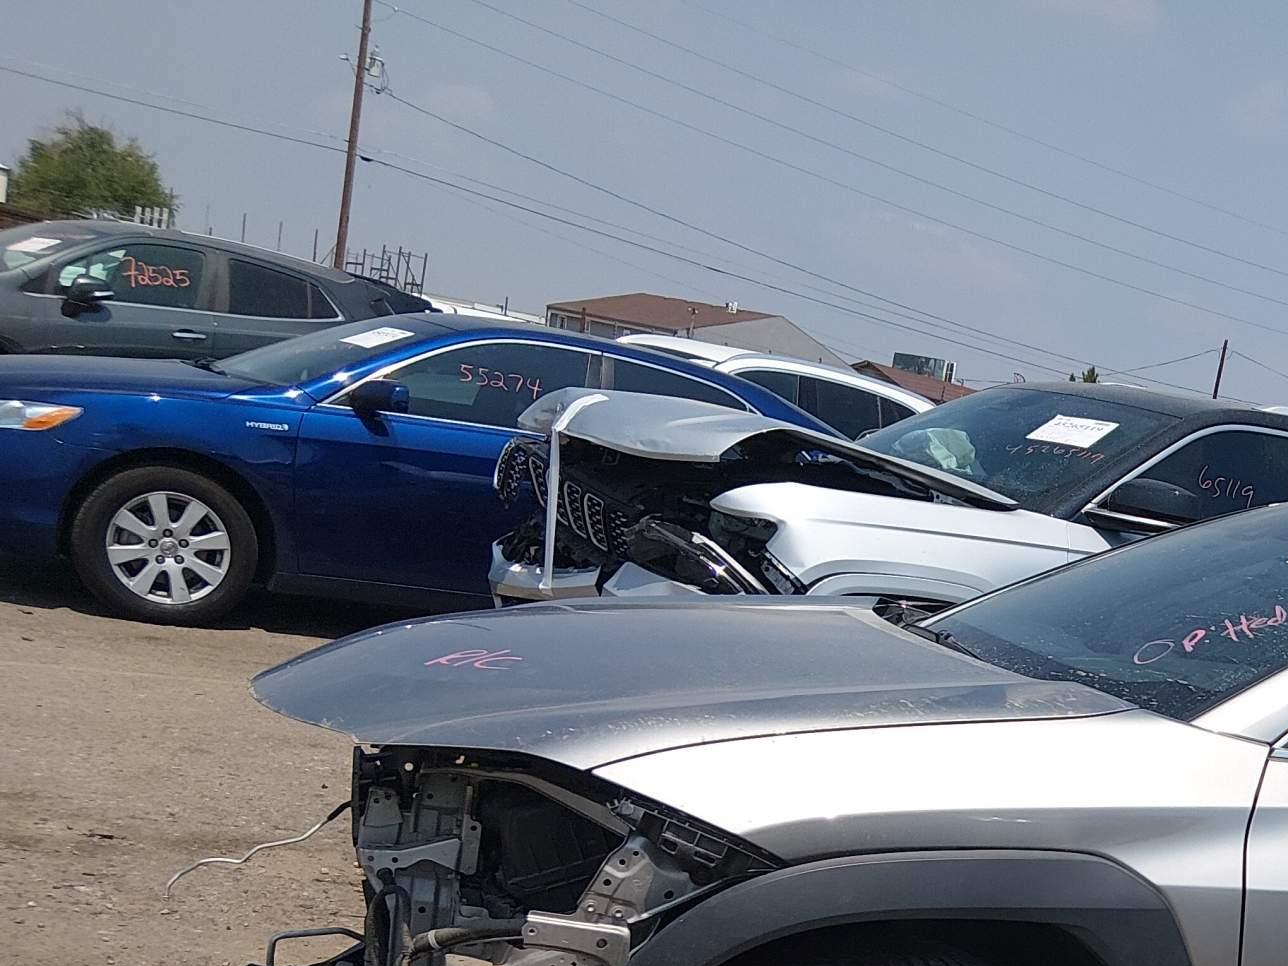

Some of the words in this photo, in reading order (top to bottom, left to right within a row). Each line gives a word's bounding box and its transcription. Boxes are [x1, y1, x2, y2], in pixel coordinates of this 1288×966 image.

[120, 256, 191, 288] 72525
[459, 363, 543, 400] 55274
[1198, 464, 1254, 509] 65119
